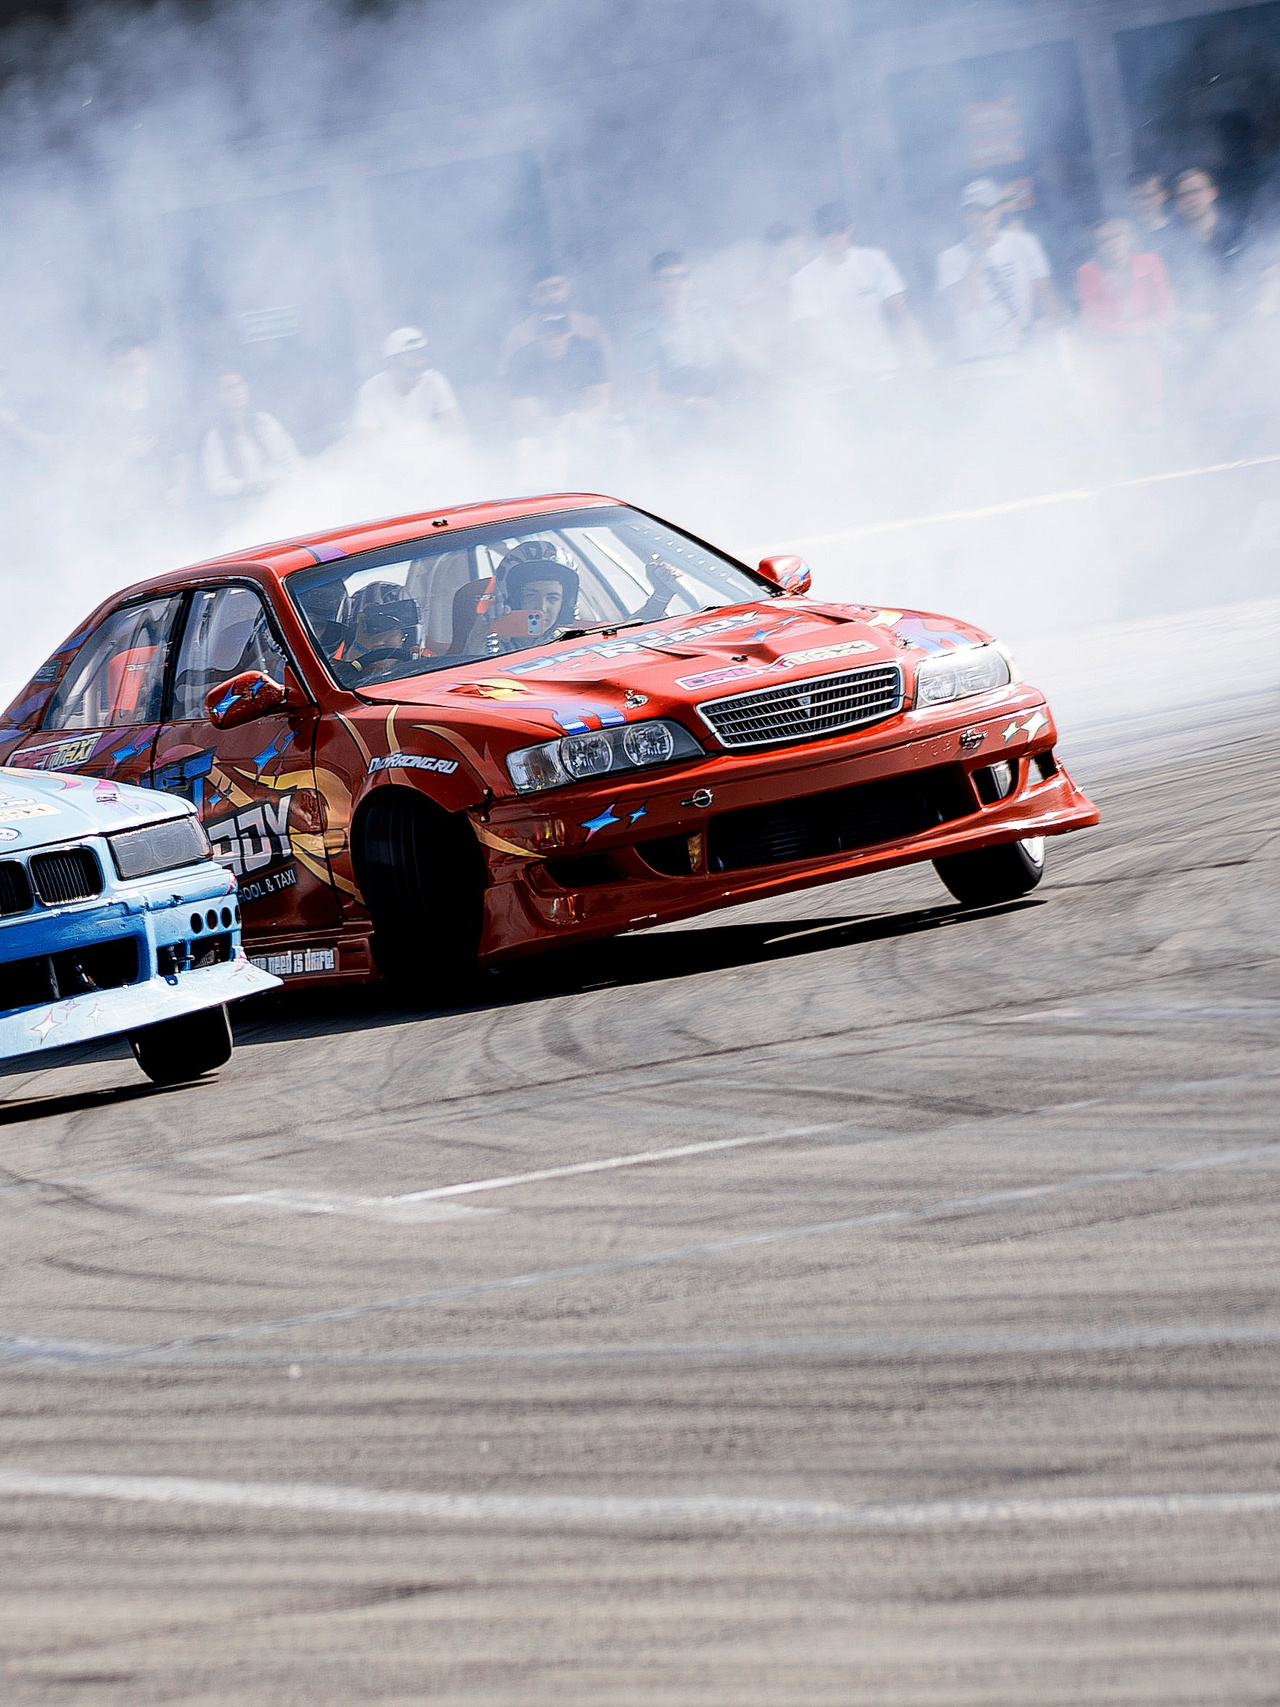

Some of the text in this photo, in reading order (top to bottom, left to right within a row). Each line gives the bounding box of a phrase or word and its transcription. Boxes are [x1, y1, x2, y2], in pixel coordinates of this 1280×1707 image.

[54, 738, 96, 766] TAXI
[208, 795, 292, 876] ADY
[265, 878, 274, 892] &
[273, 869, 297, 889] TAXI
